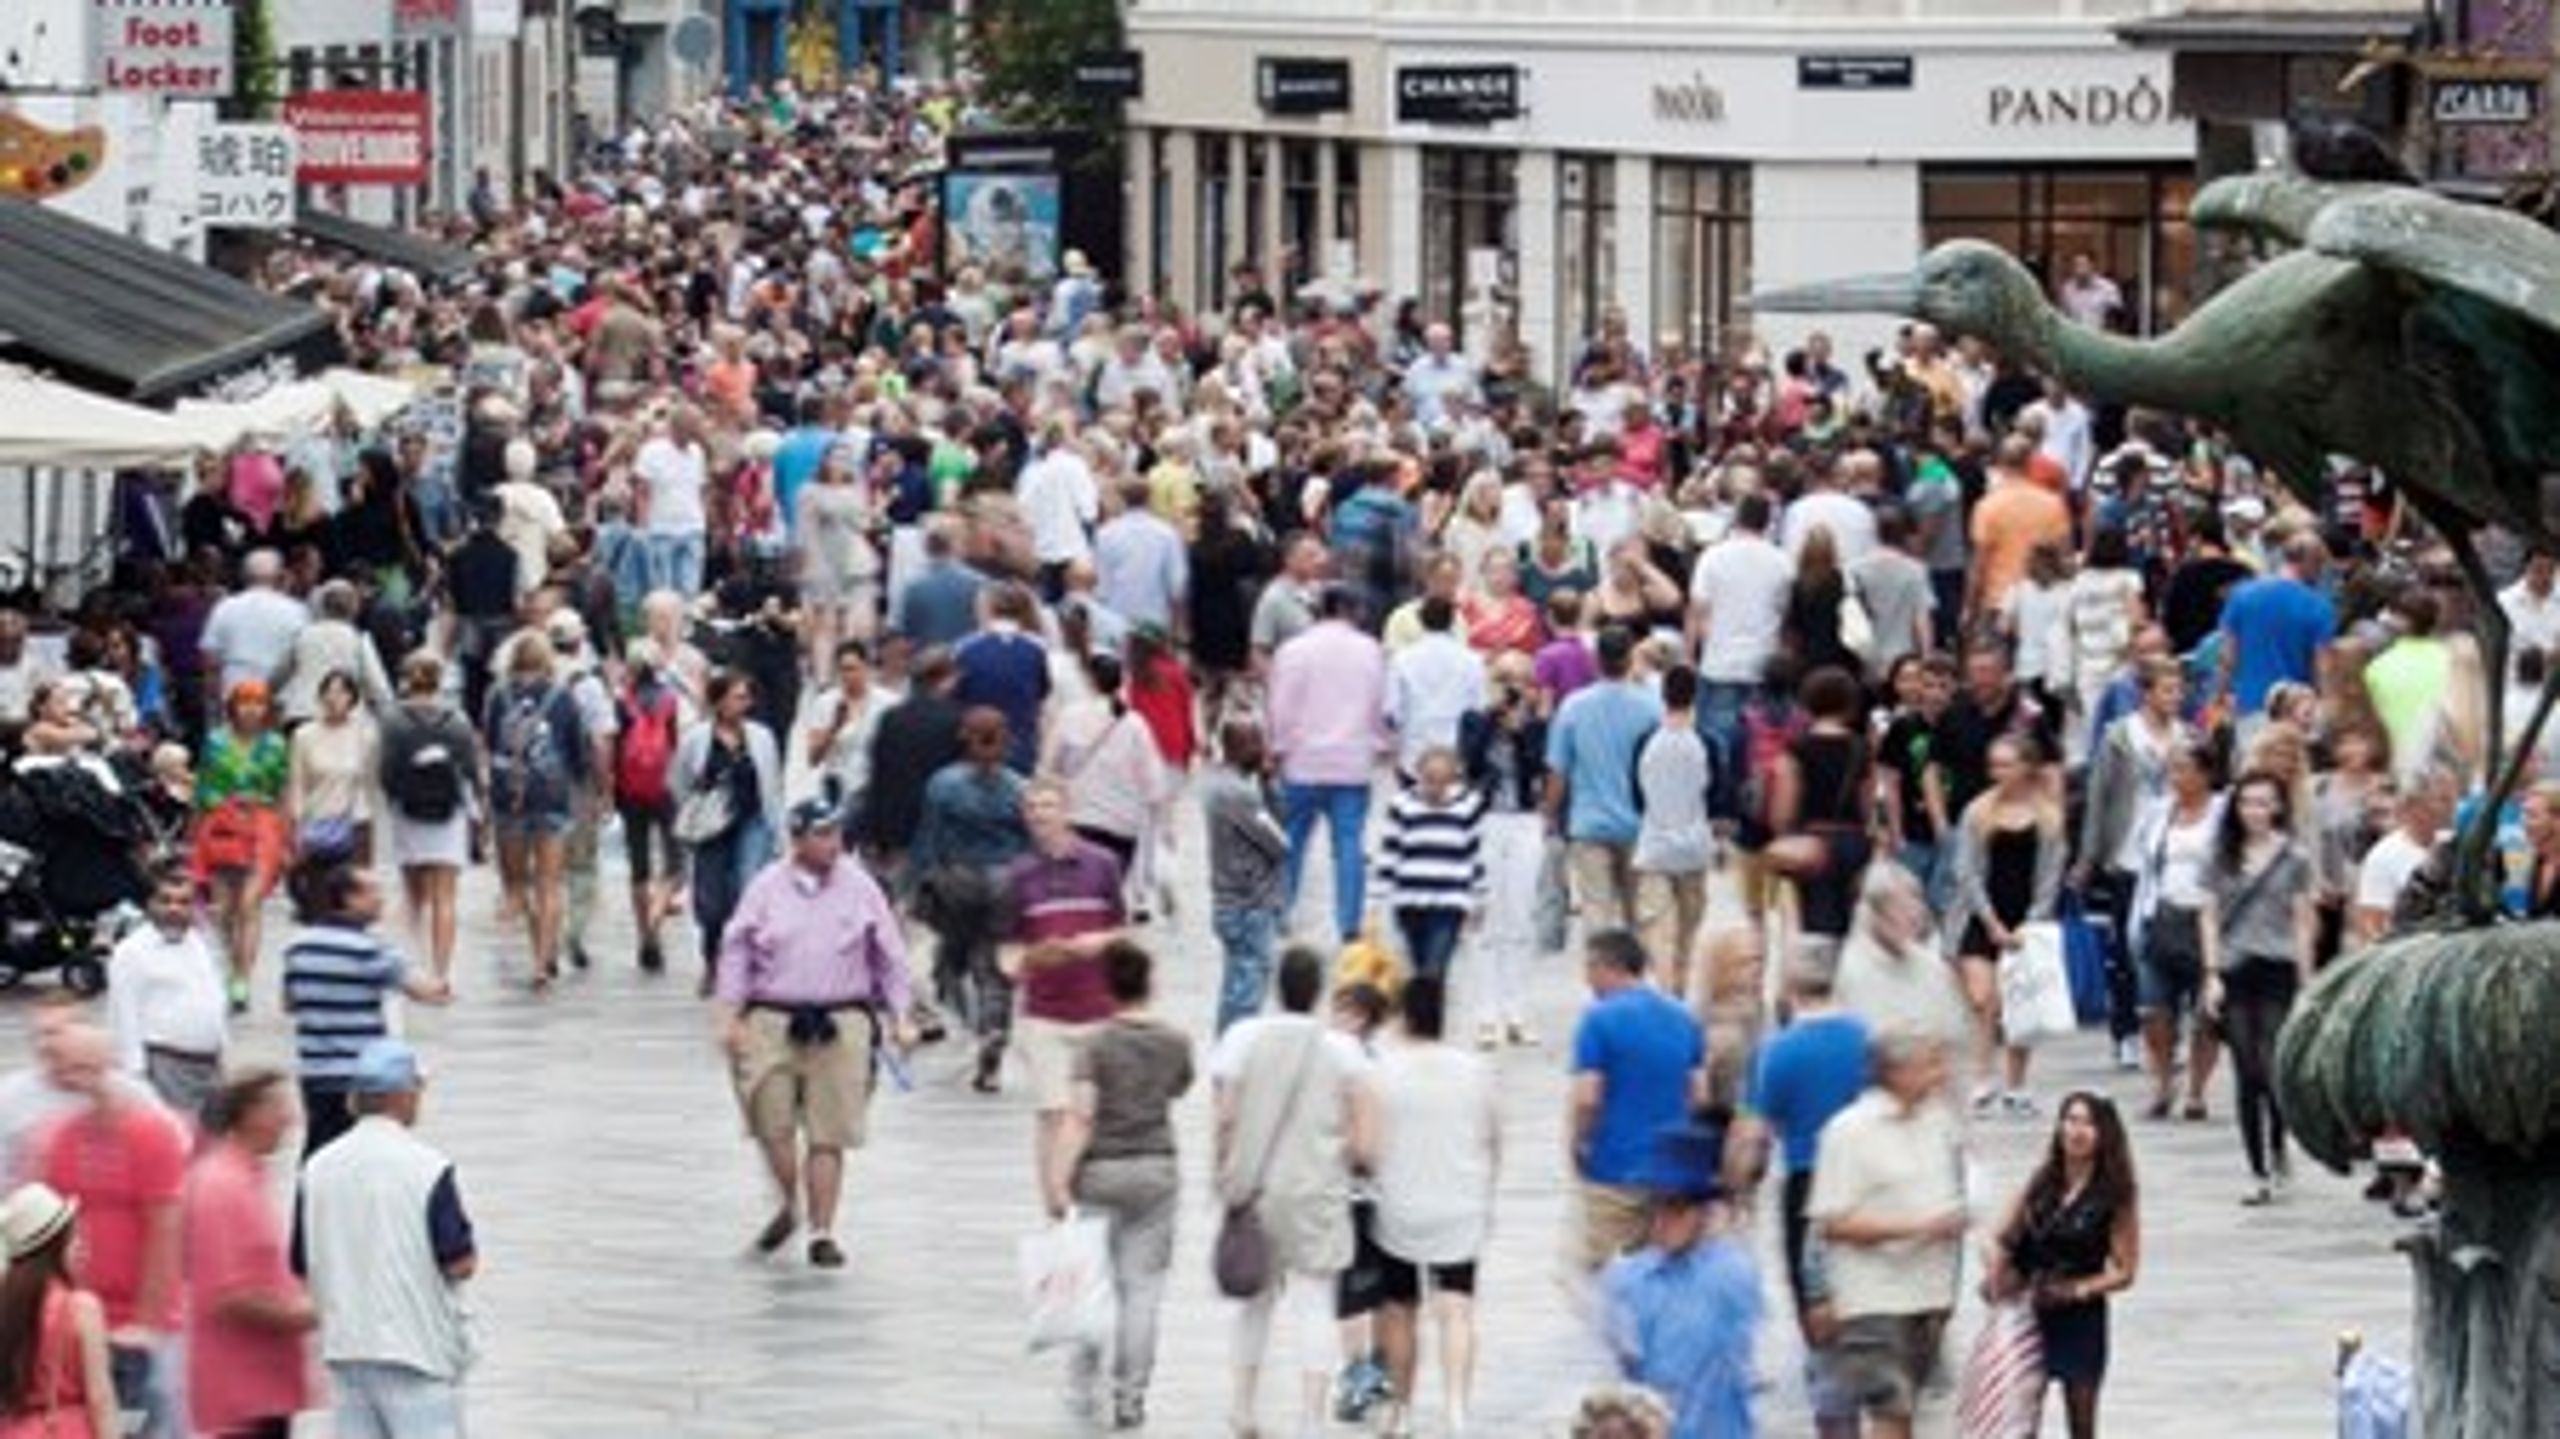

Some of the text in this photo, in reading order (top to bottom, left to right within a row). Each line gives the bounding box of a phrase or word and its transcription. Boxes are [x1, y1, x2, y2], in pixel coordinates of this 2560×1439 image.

[124, 16, 200, 47] Foot
[107, 57, 222, 88] Locker
[1403, 75, 1509, 99] CHANGE
[198, 133, 289, 177] 琥珀
[198, 190, 288, 218] コハク
